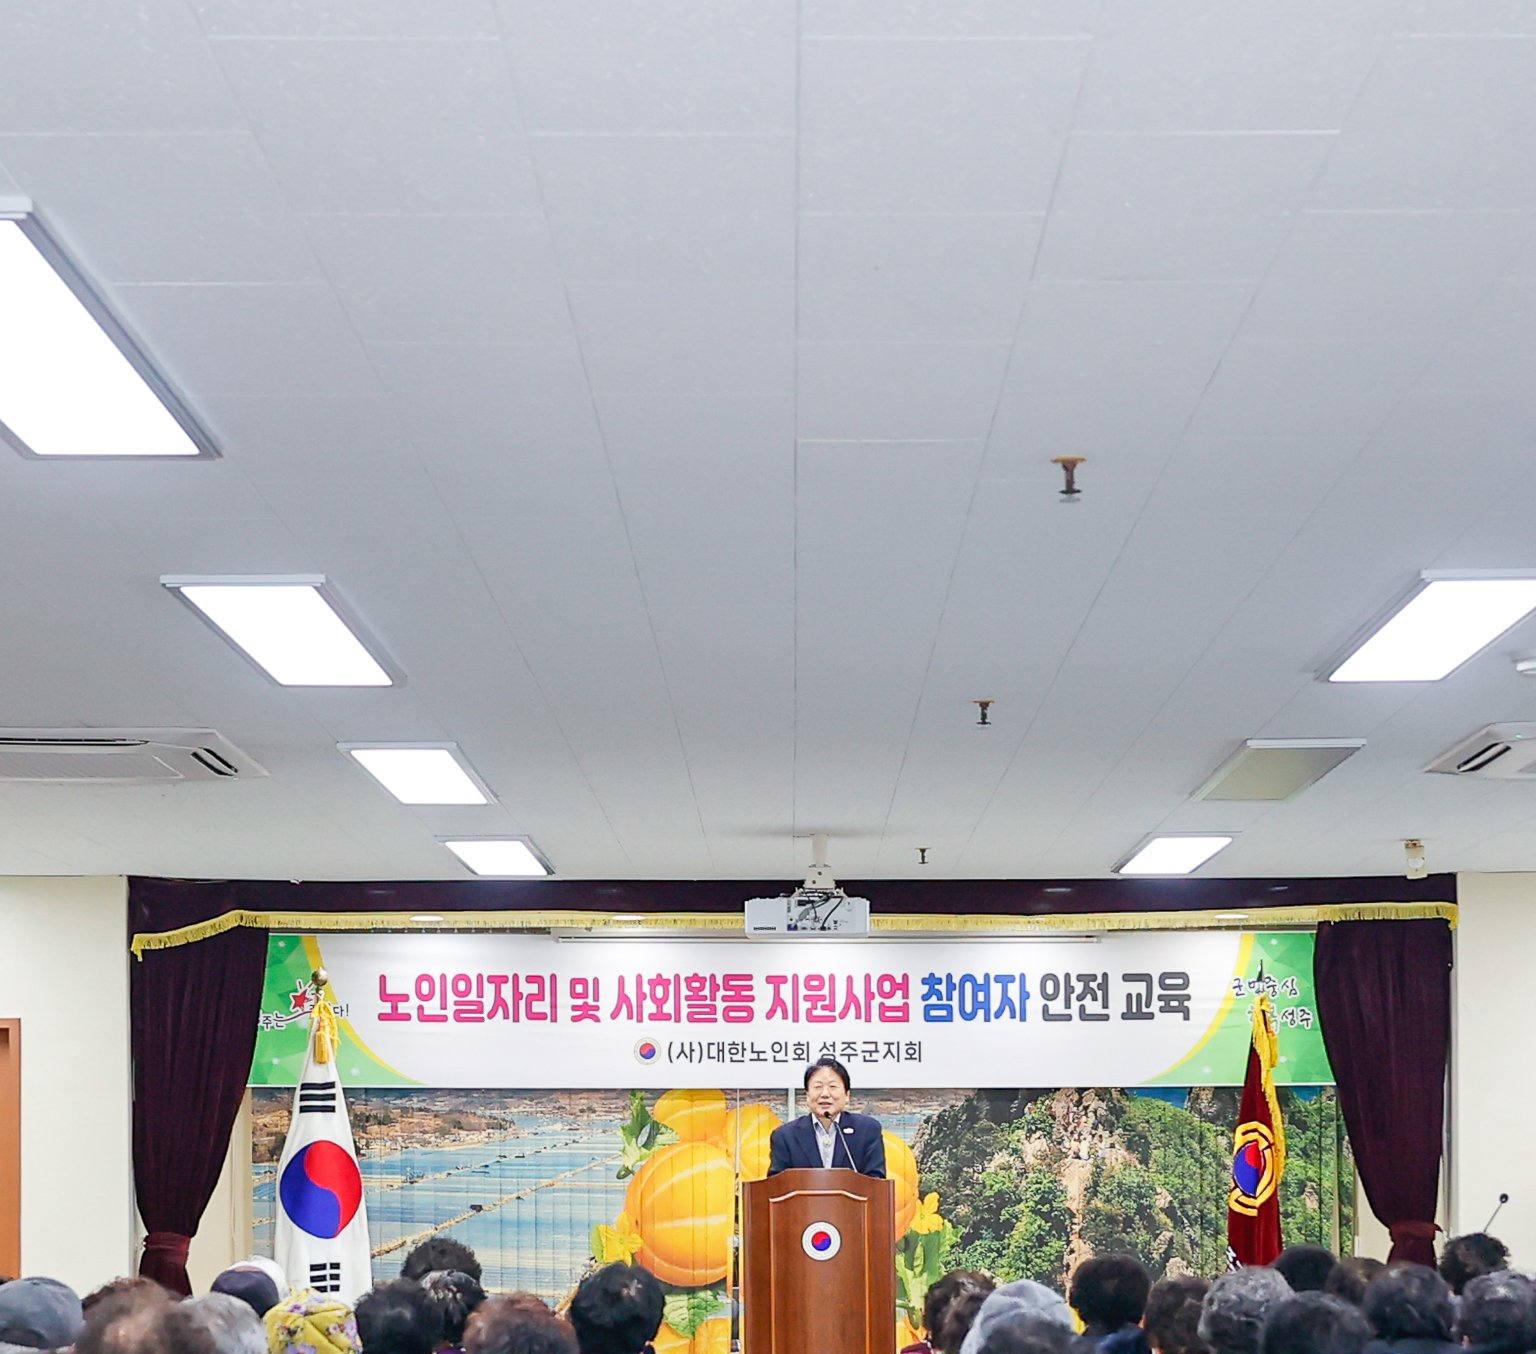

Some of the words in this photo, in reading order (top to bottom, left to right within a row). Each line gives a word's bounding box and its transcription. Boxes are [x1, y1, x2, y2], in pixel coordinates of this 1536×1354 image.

[377, 972, 558, 1024] 노인일자리
[569, 976, 602, 1023] 및
[609, 972, 756, 1024] 사회활동
[764, 972, 910, 1024] 지원사업
[920, 971, 1031, 1023] 참여자
[1039, 971, 1111, 1022] 안전
[1120, 971, 1192, 1022] 교육
[667, 1041, 810, 1064] (사)대한노인회
[819, 1041, 922, 1063] 성주군지회
